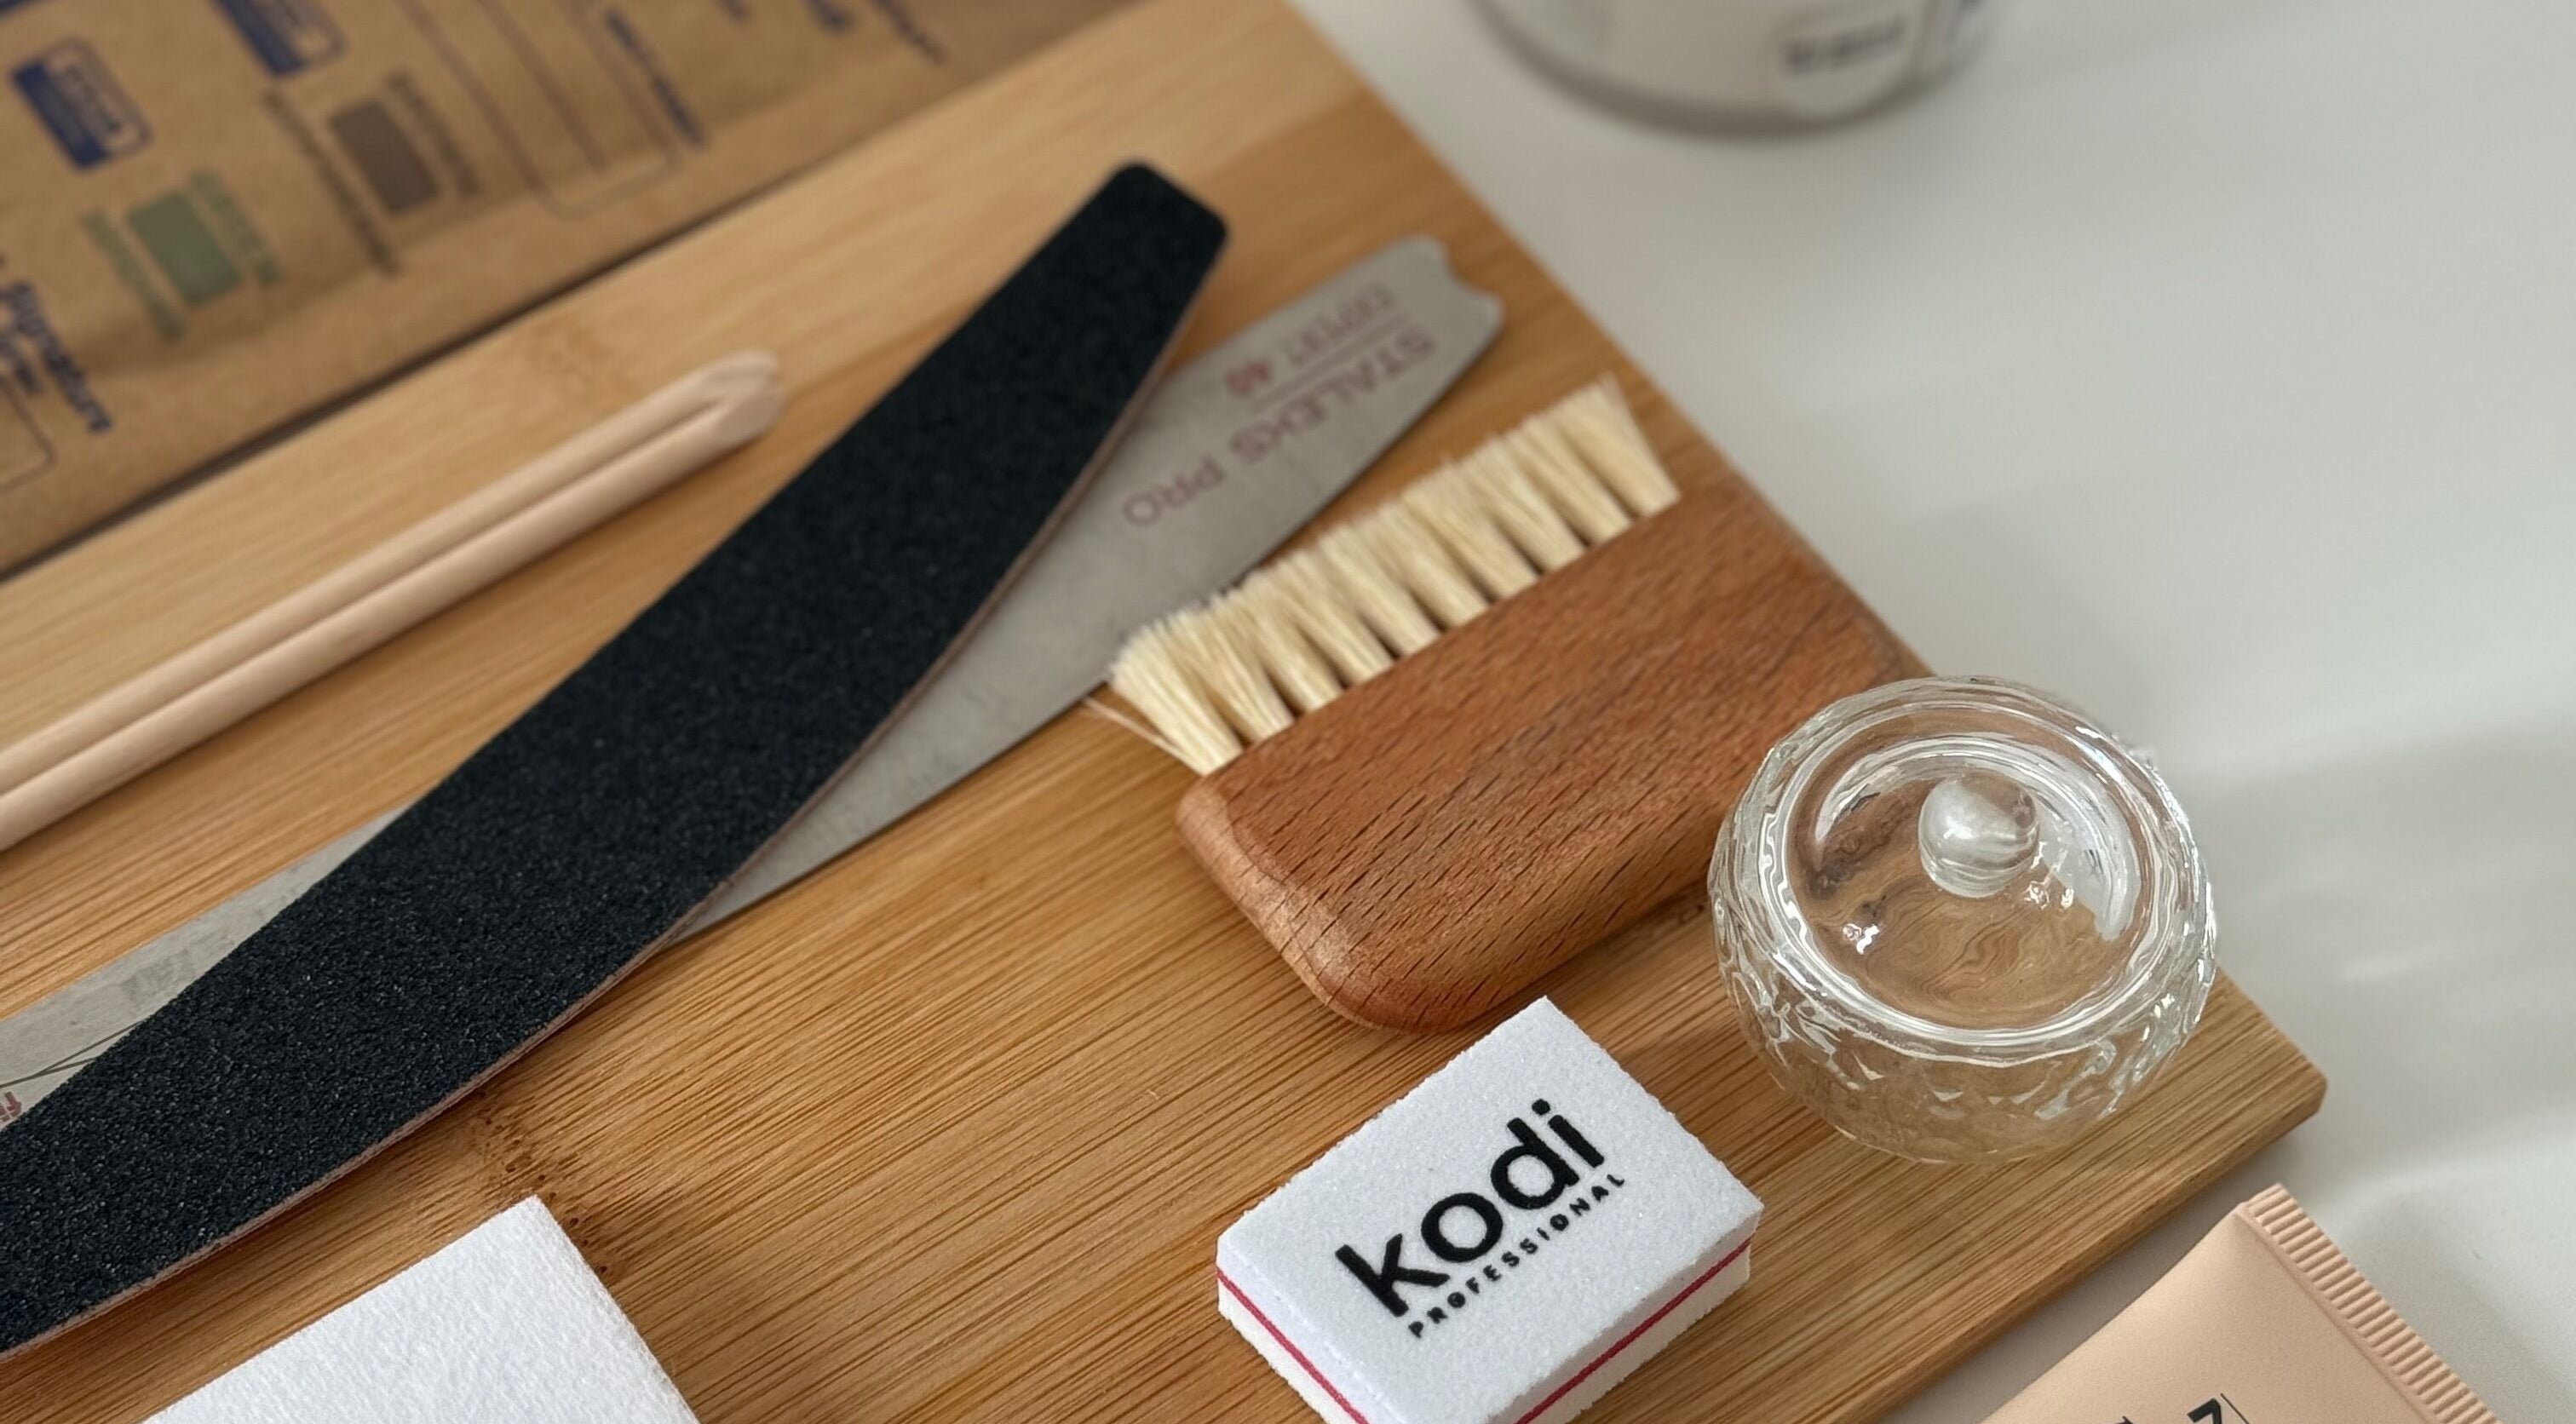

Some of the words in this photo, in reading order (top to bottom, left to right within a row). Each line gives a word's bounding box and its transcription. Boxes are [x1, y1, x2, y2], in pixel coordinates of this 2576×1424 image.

[1229, 328, 1436, 462] STALEKS
[1122, 456, 1225, 525] PRO
[1335, 1098, 1605, 1318] kodi
[1408, 1174, 1625, 1338] PROFESSIONAL
